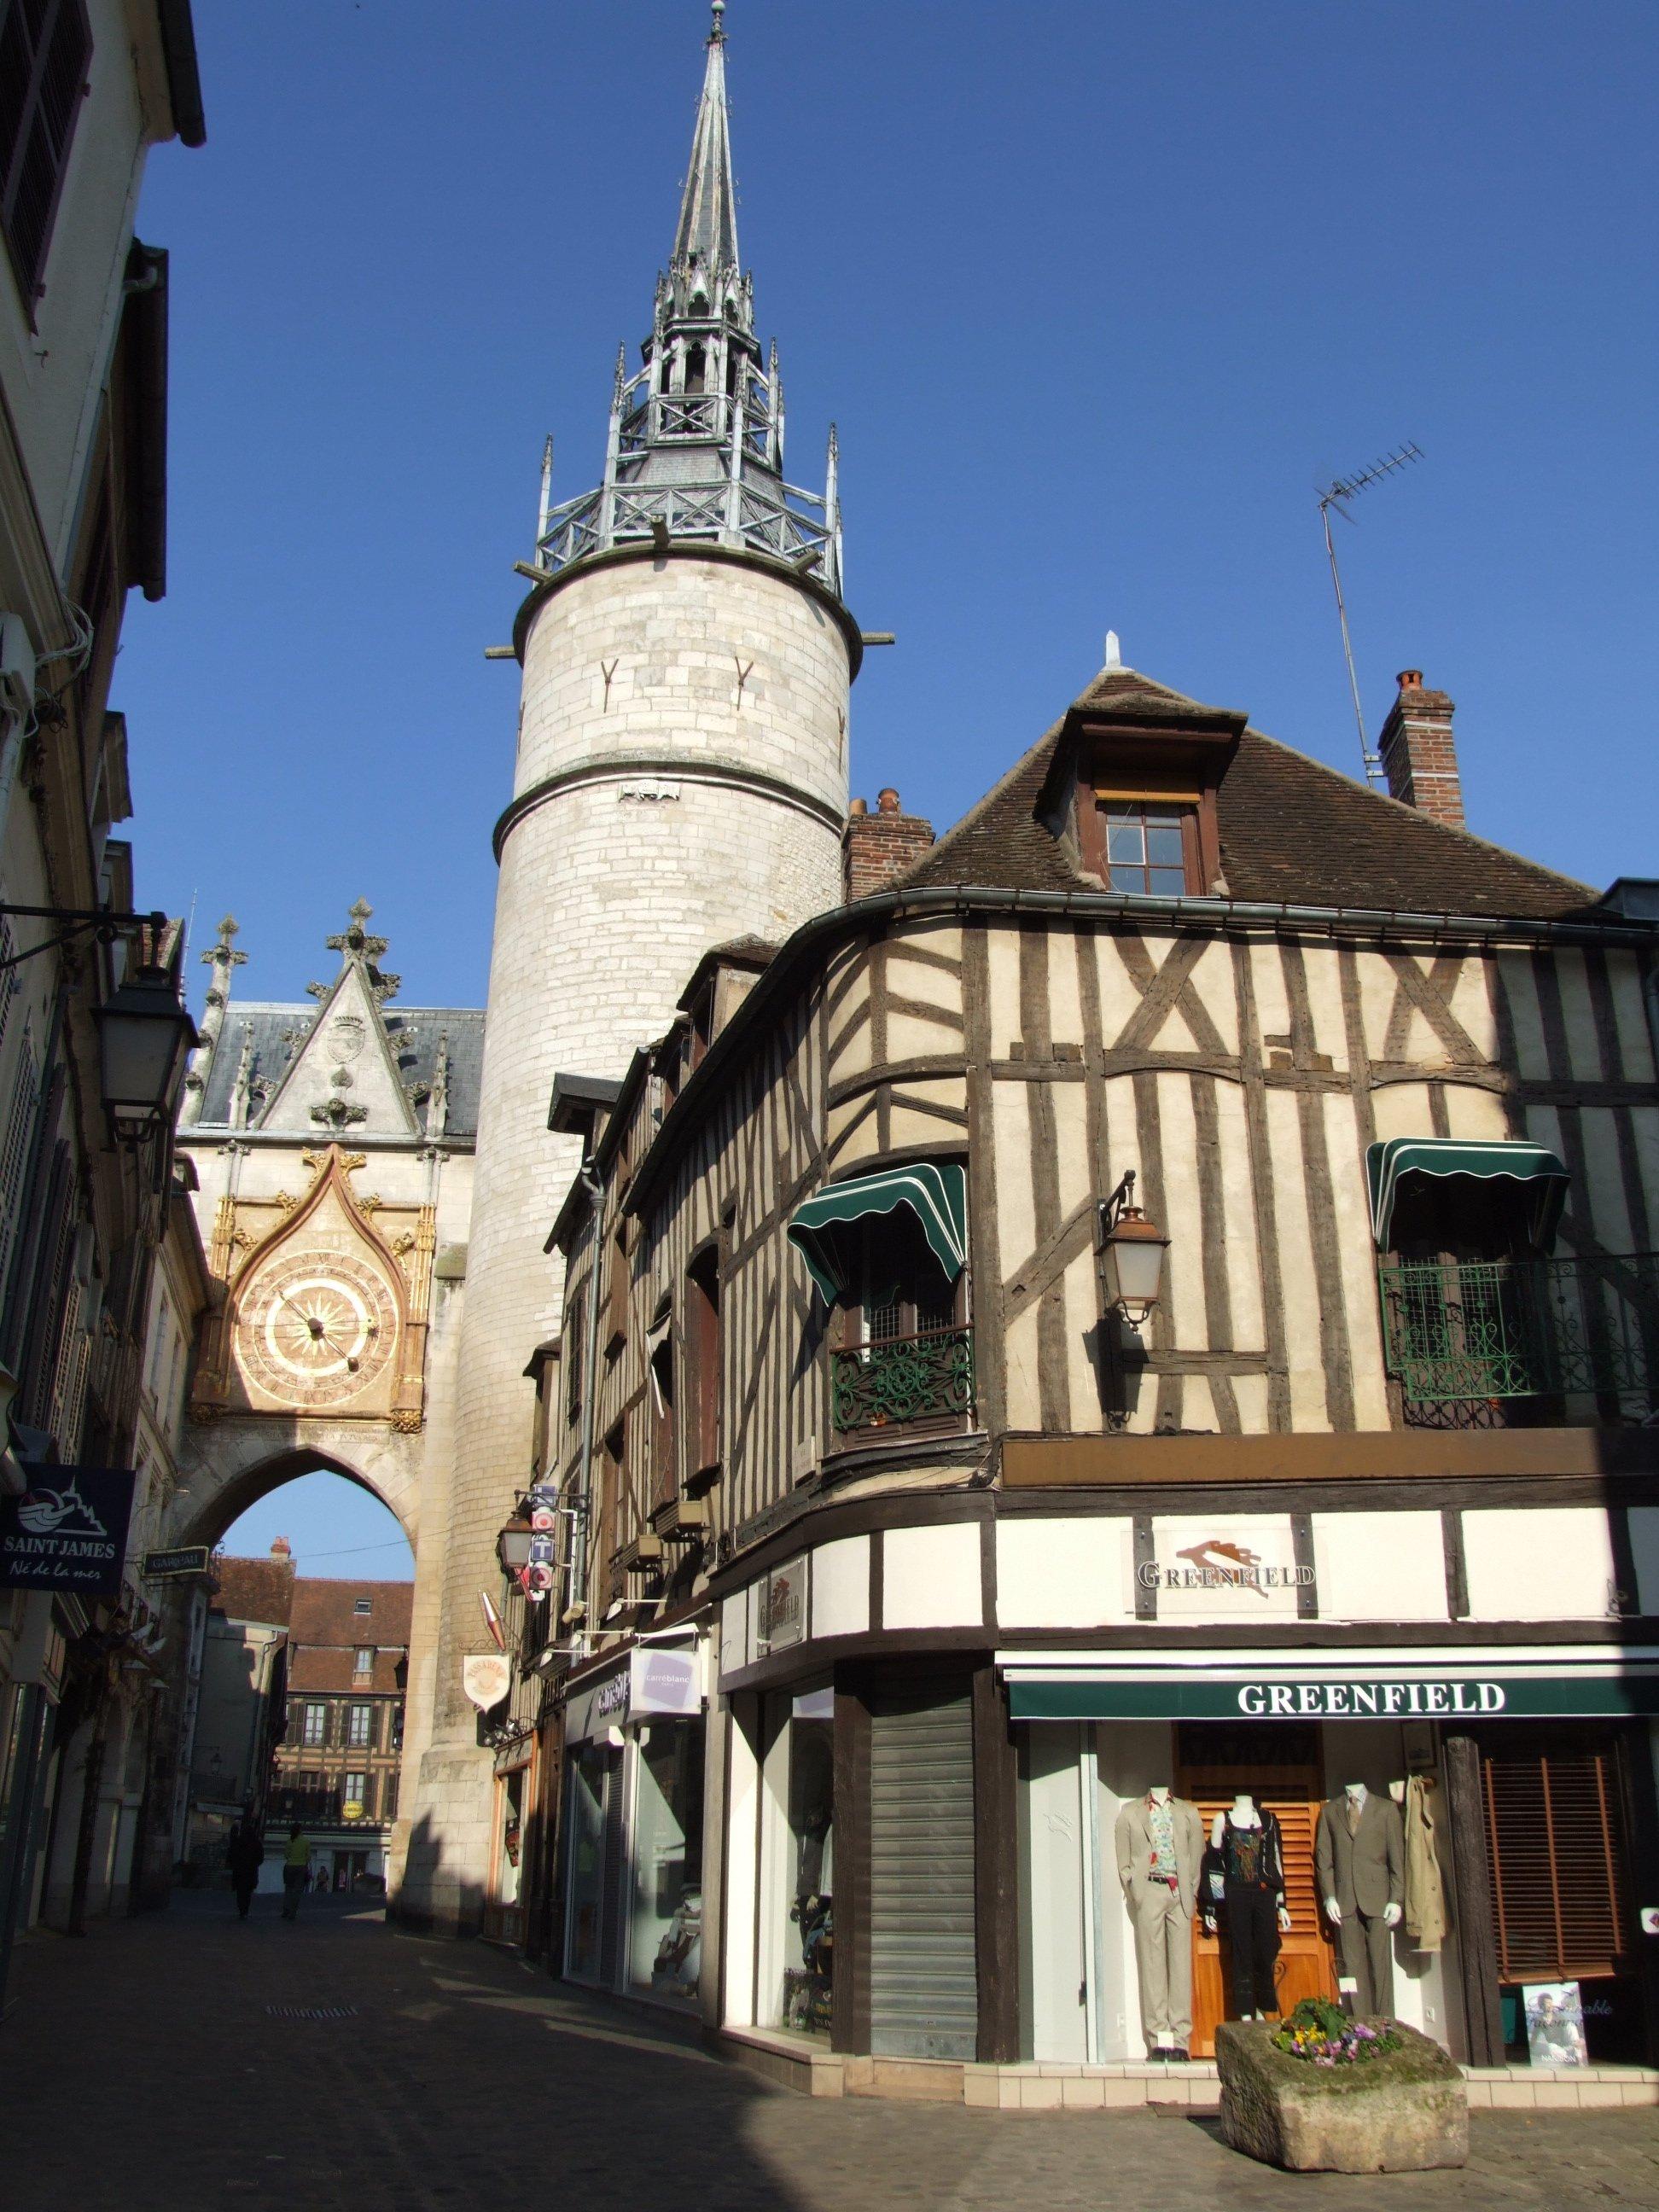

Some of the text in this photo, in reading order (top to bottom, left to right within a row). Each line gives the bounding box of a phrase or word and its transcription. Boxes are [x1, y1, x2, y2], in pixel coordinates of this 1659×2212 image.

[4, 1536, 115, 1559] SAINT JAMES
[9, 1560, 102, 1580] Né de la mer
[1138, 1560, 1317, 1589] GREENFIELD
[1237, 1682, 1506, 1714] GREENFIELD
